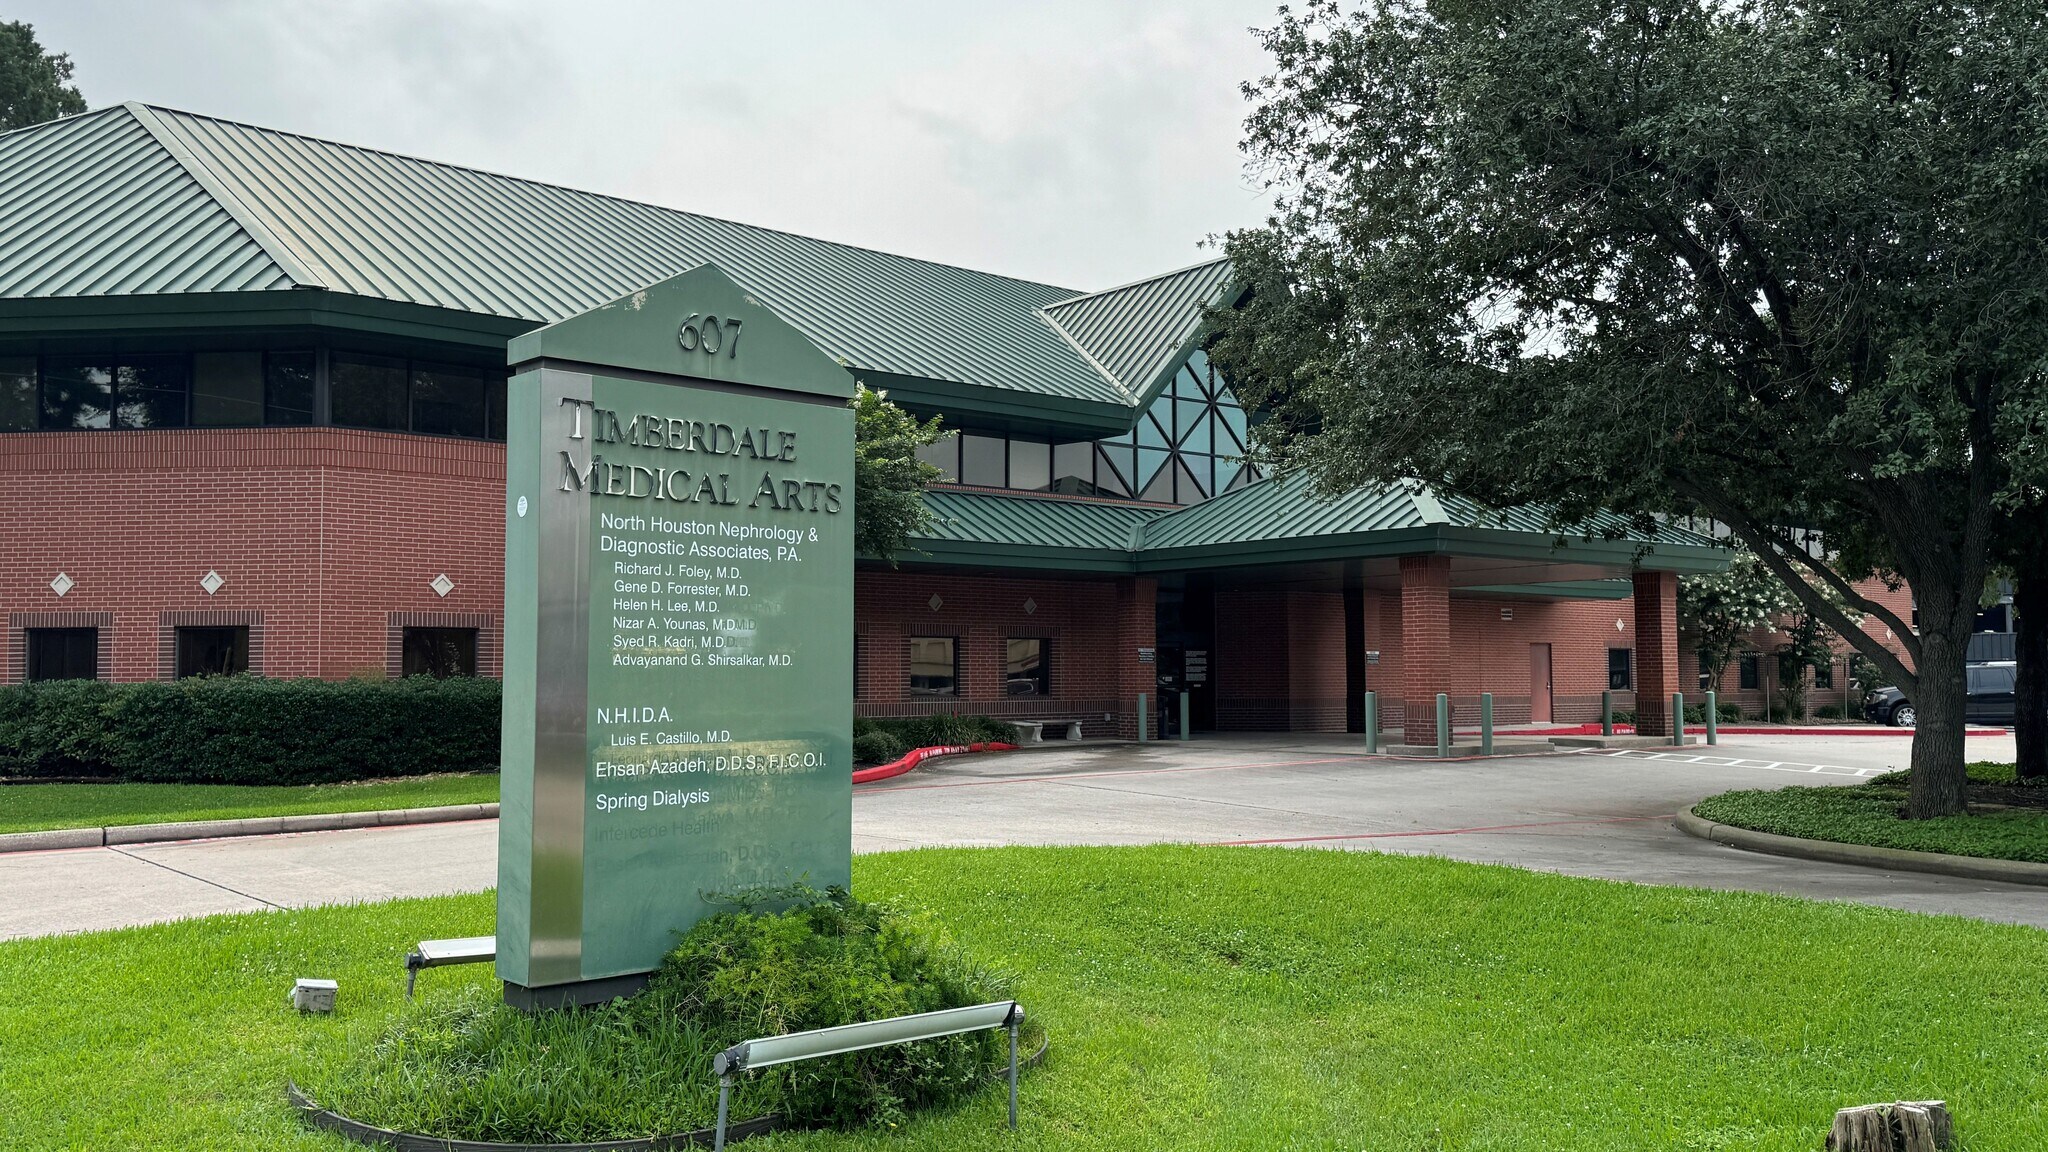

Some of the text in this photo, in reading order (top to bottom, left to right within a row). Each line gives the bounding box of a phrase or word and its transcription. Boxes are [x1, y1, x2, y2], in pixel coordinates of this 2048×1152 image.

[679, 312, 743, 358] 607
[601, 512, 819, 545] North Houston Nephrology &
[600, 535, 802, 563] Diagnostic Associates, P.A.
[614, 561, 741, 580] Richard J. Foley, M.D.
[614, 579, 751, 597] Gene D. Forrester, M.D.
[613, 597, 648, 611] Helen
[651, 598, 664, 612] H.
[667, 599, 691, 614] Lee,
[695, 600, 720, 613] M.D.
[613, 616, 645, 630] Nizar
[647, 617, 660, 630] A.
[663, 617, 709, 633] Younas,
[613, 634, 645, 650] Syed
[648, 635, 660, 648] R.
[664, 635, 697, 650] Kadri,
[701, 636, 727, 648] M.D.
[613, 653, 794, 669] Advayanand G. Shirsalkar, M.D.
[597, 706, 674, 724] N.H.I.D.A.
[611, 730, 733, 747] Luis E. Castillo, M.D.
[596, 761, 645, 778] Ehsan
[650, 757, 710, 775] Azadeh,
[768, 752, 827, 769] F.I.C.O.I.
[596, 793, 648, 813] Spring
[653, 788, 710, 808] Dialysis
